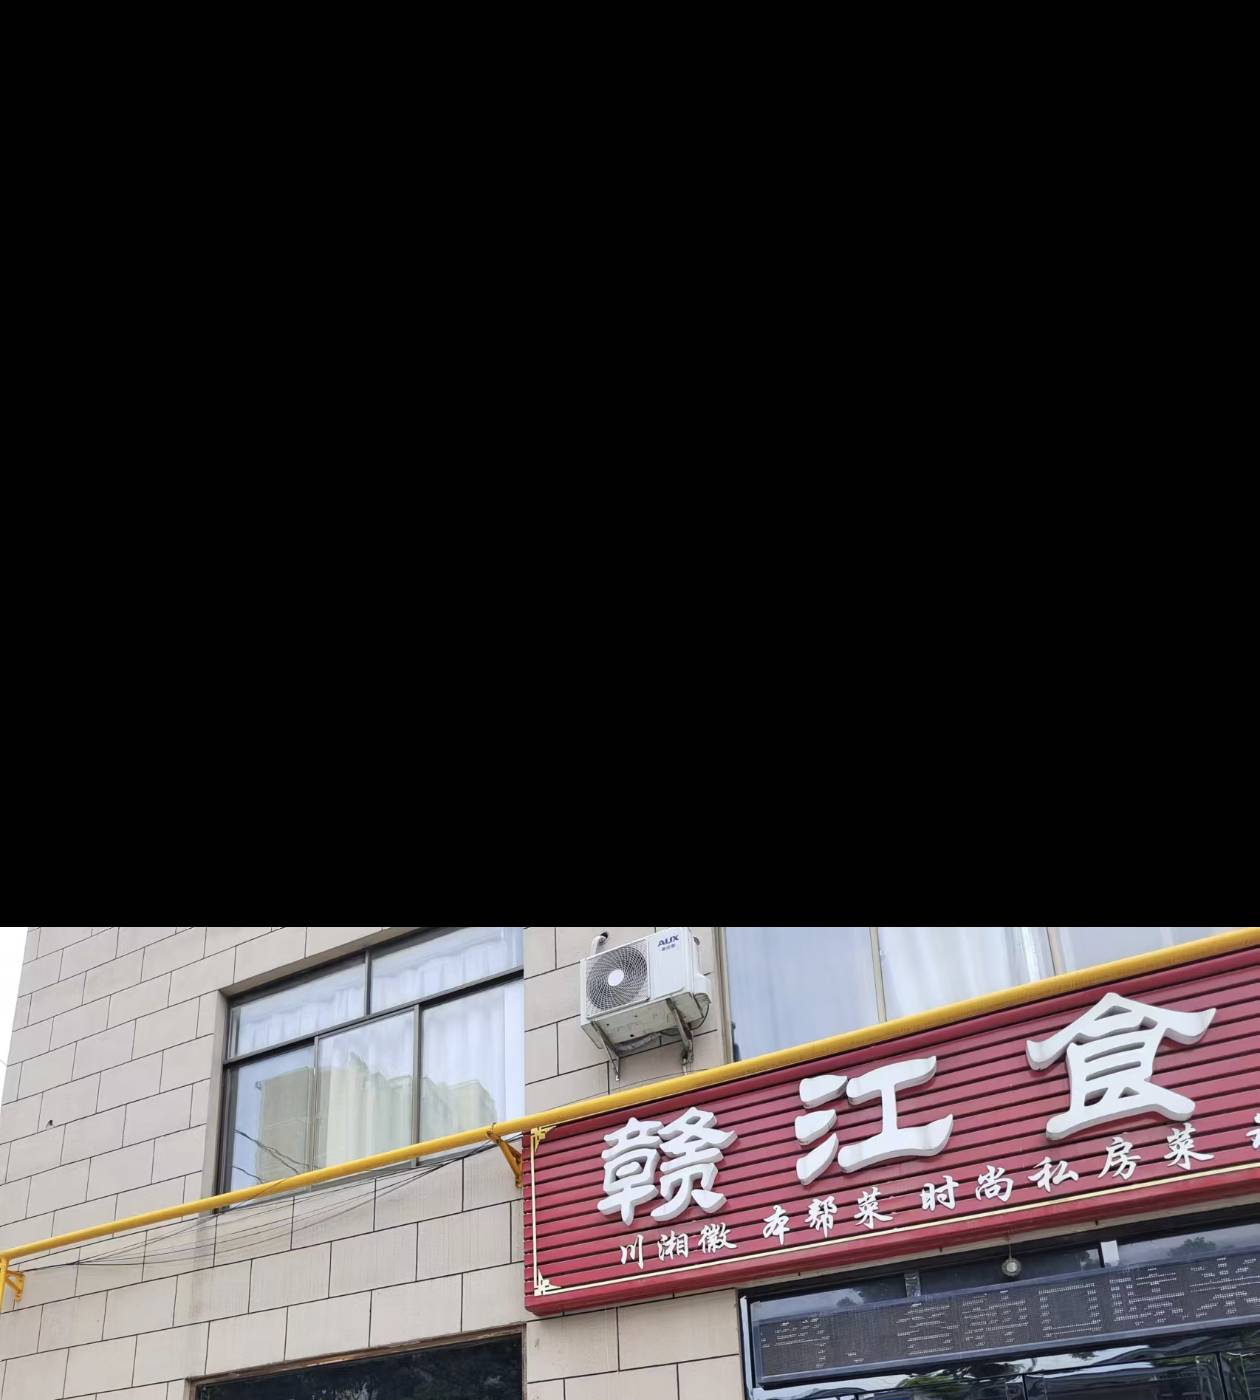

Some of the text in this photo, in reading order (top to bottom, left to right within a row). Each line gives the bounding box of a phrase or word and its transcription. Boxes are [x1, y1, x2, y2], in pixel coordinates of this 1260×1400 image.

[657, 934, 680, 948] AUX
[597, 991, 1216, 1227] 赣江食
